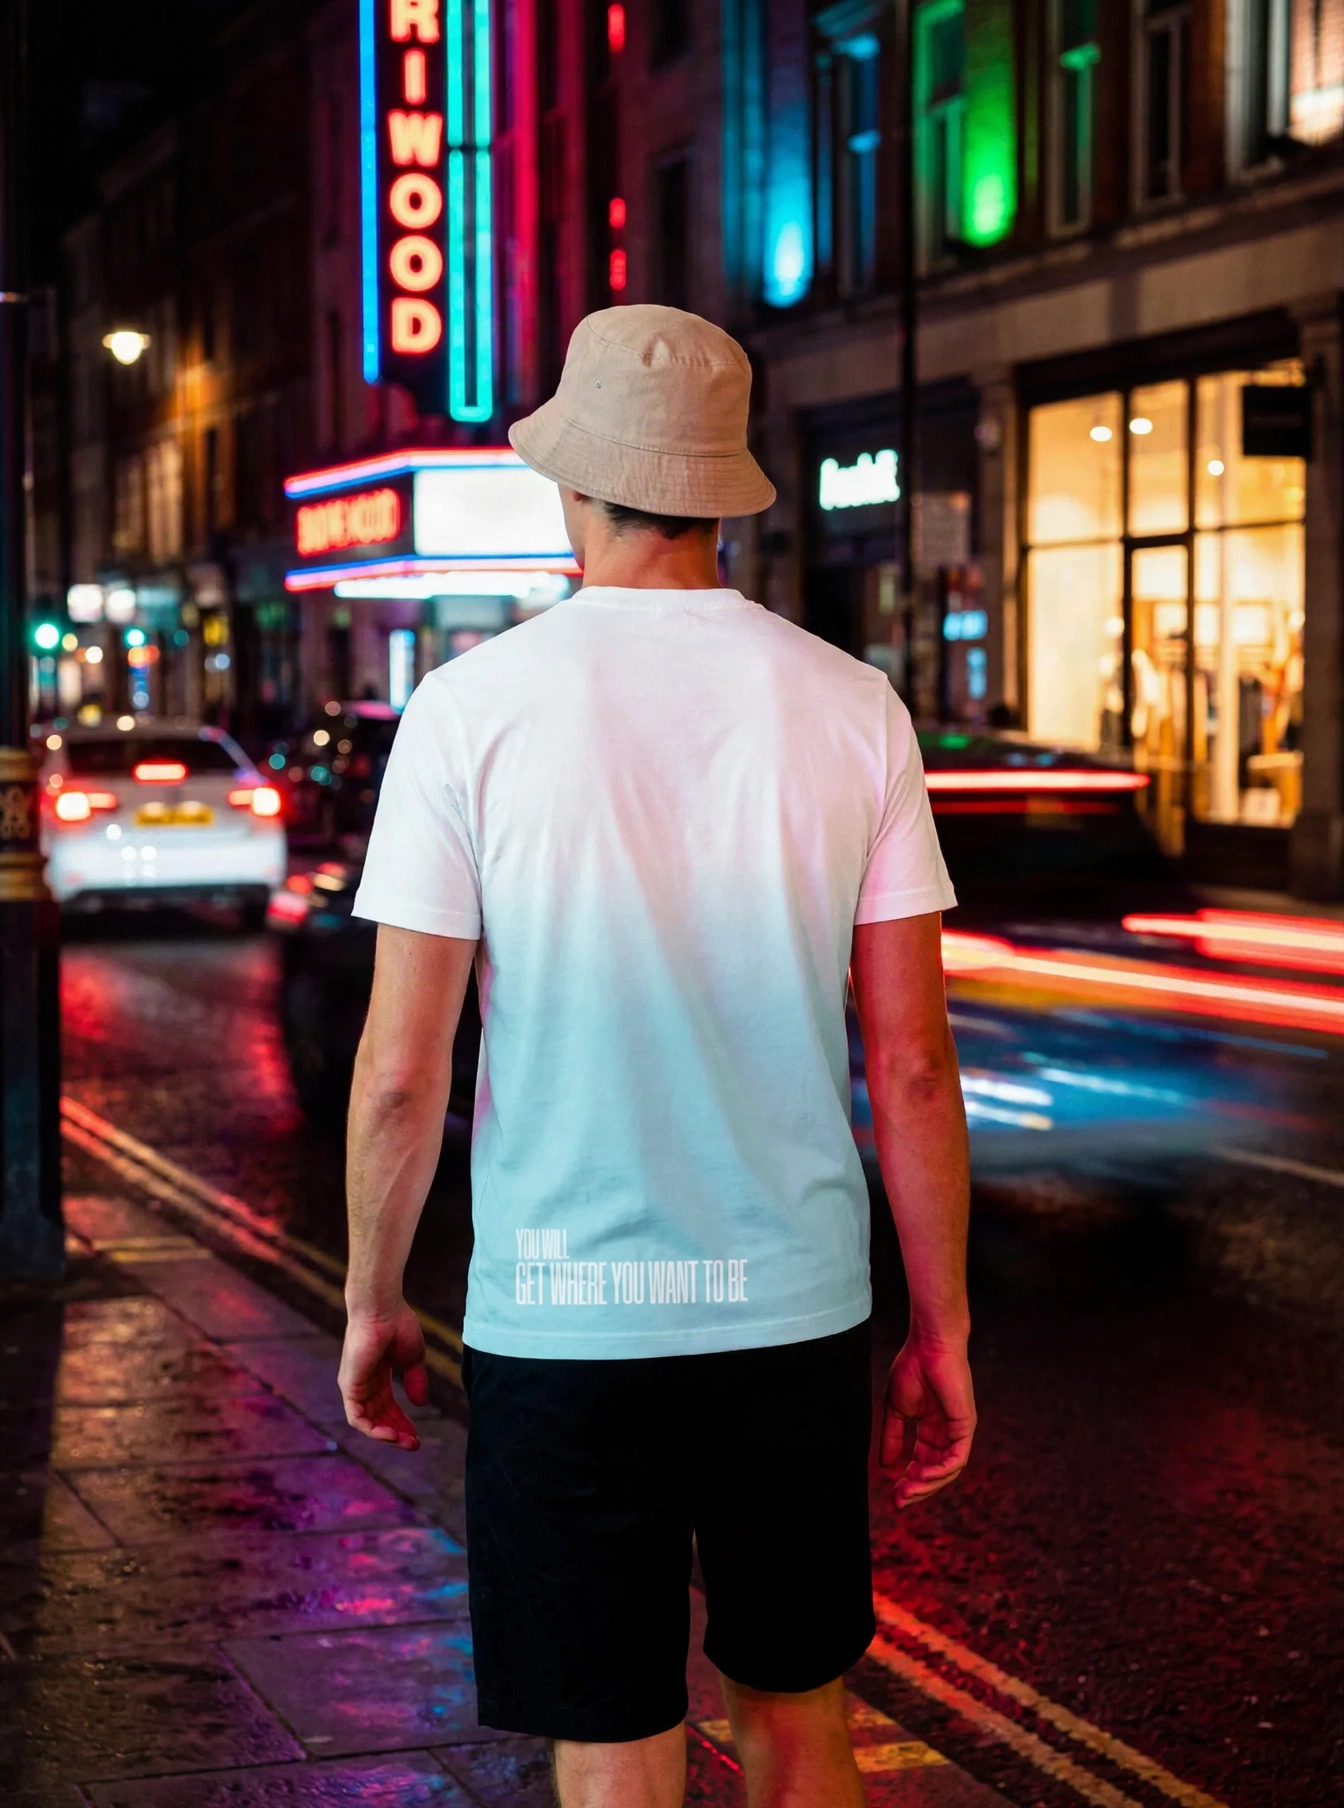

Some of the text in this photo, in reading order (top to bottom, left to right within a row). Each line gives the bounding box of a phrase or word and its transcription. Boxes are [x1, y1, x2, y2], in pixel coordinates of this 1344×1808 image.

[516, 1229, 569, 1260] YOU WILL
[515, 1259, 748, 1305] GET WHERE YOU WANT TO BE
